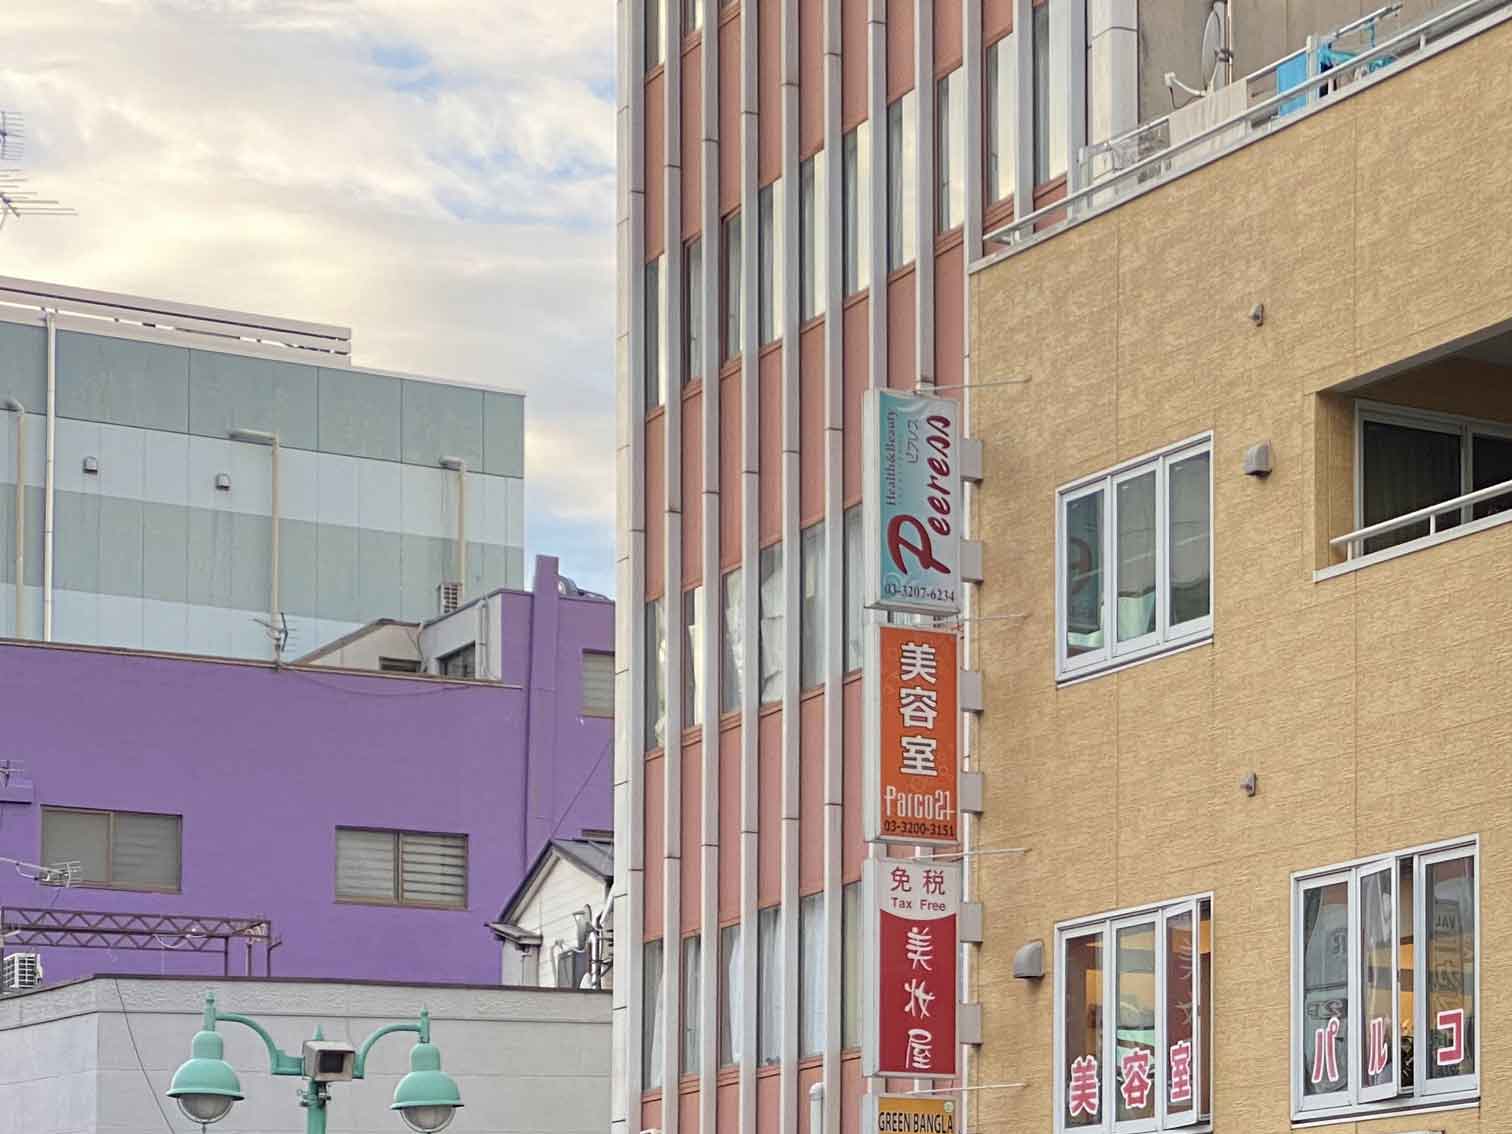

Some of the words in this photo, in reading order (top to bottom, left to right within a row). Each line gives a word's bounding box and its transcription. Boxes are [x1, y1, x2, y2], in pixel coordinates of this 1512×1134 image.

[888, 414, 952, 576] Peeress
[900, 642, 938, 777] 美容室
[889, 866, 947, 897] 免税
[890, 897, 913, 910] Tax
[919, 898, 947, 912] Free
[1069, 1040, 1194, 1118] 美容室
[1312, 1009, 1465, 1084] パルコ
[878, 1112, 910, 1133] GREEN
[911, 1111, 954, 1134] BANGLA
